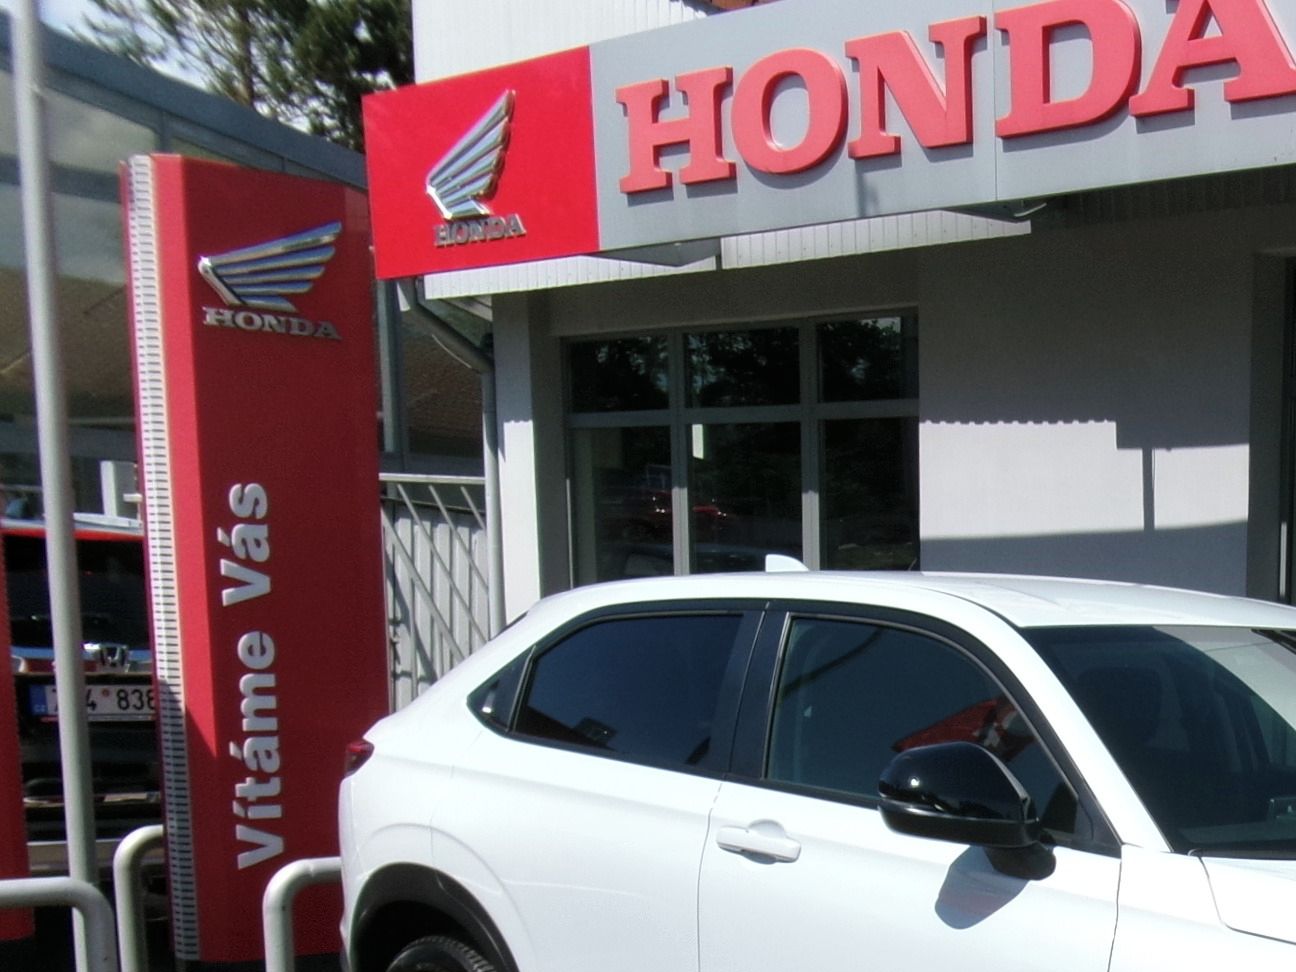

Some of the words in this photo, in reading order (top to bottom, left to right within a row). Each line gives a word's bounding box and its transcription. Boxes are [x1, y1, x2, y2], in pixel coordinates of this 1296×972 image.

[433, 213, 527, 248] HONDA
[202, 306, 342, 341] HONDA
[216, 482, 272, 607] Vás
[229, 630, 284, 871] Vítáme
